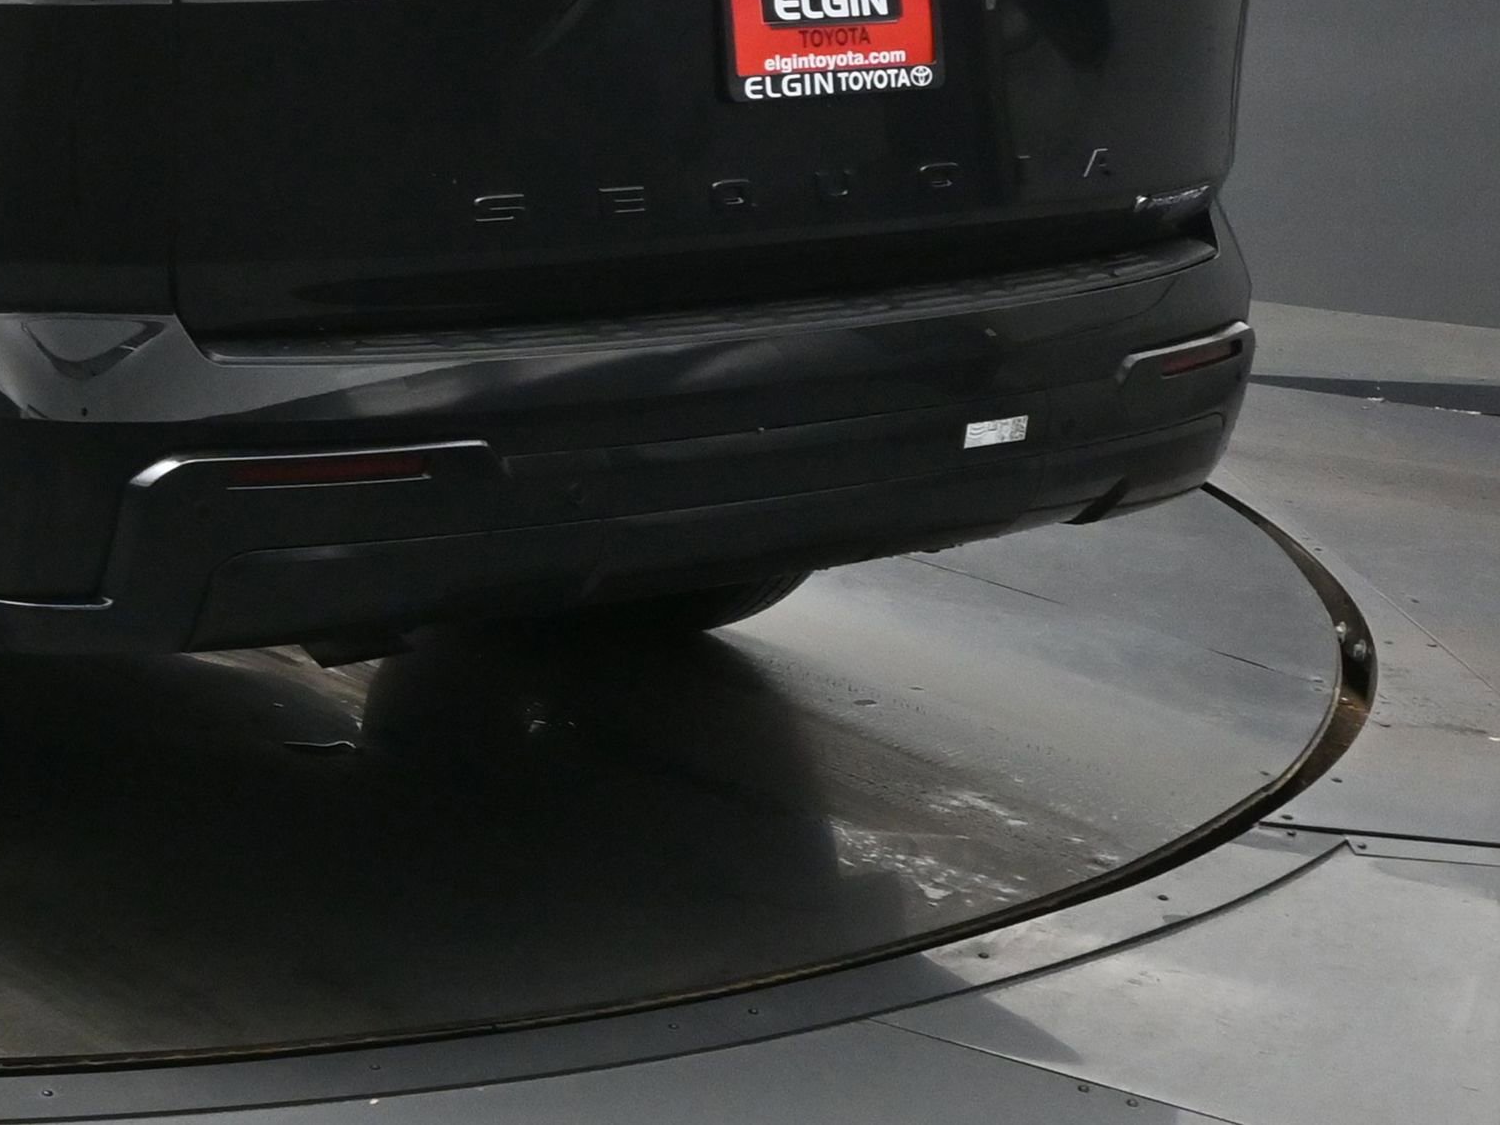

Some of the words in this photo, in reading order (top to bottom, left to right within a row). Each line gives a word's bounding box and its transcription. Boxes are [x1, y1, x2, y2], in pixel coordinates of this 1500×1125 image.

[798, 27, 871, 49] TOYOTA
[764, 49, 907, 73] elgintoyota.com
[744, 71, 836, 100] ELGIN
[837, 68, 912, 92] TOYOTA
